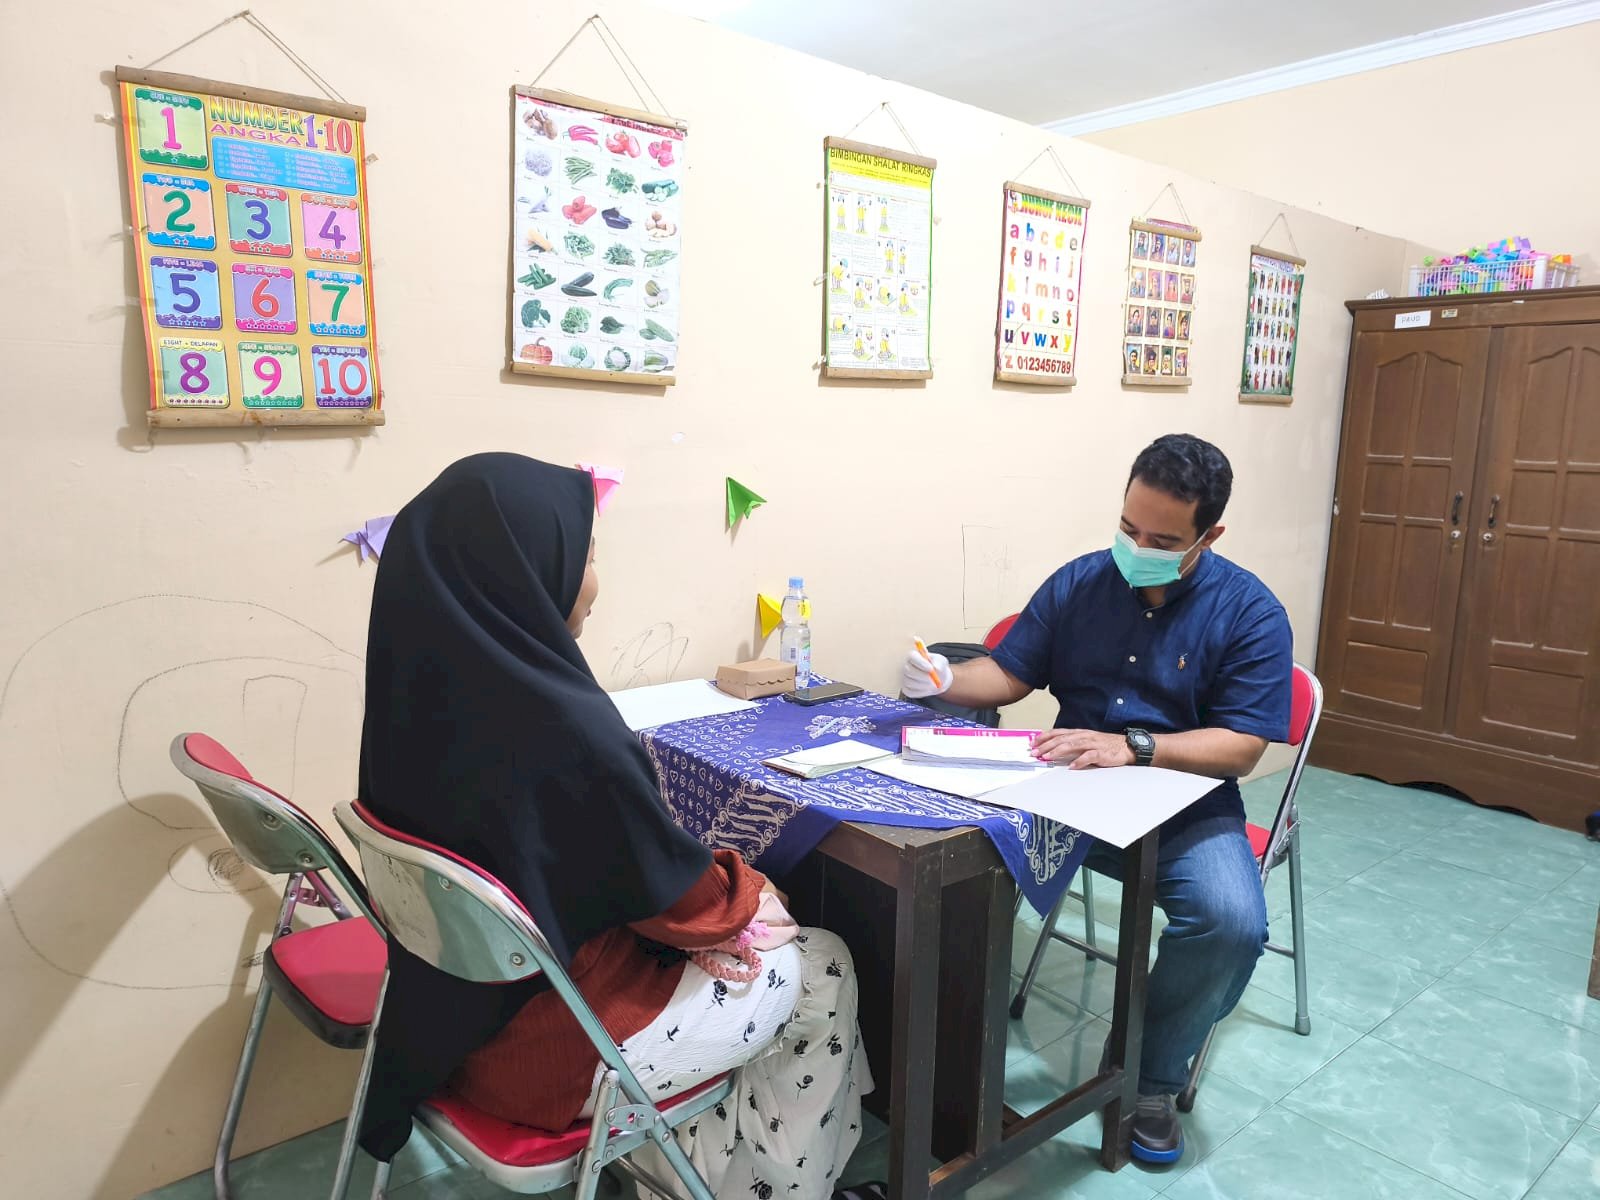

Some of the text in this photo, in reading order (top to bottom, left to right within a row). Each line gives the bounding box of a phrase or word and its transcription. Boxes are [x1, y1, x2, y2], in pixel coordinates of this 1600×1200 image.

[160, 107, 182, 149] 1
[209, 95, 304, 135] NUMBER
[210, 123, 301, 146] ANGKA
[873, 157, 900, 171] SHALAT
[163, 190, 196, 232] 2
[244, 199, 272, 241] 3
[319, 210, 347, 249] 4
[1010, 223, 1019, 239] a
[1026, 222, 1035, 241] b
[1040, 231, 1048, 245] c
[1069, 237, 1078, 251] e
[1010, 246, 1017, 266] f
[1024, 249, 1032, 267] g
[1039, 252, 1047, 271] h
[170, 273, 200, 313] 5
[251, 278, 280, 318] 6
[321, 283, 350, 322] 7
[1035, 283, 1048, 298] m
[1052, 285, 1060, 300] n
[1066, 289, 1074, 302] o
[1006, 299, 1015, 319] p
[1022, 302, 1031, 321] q
[1052, 310, 1060, 325] s
[1066, 309, 1072, 327] t
[1005, 329, 1072, 353] u v w x y
[180, 351, 210, 394] 8
[253, 355, 282, 396] 9
[317, 358, 367, 396] 10
[1017, 355, 1071, 374] 0123456789
